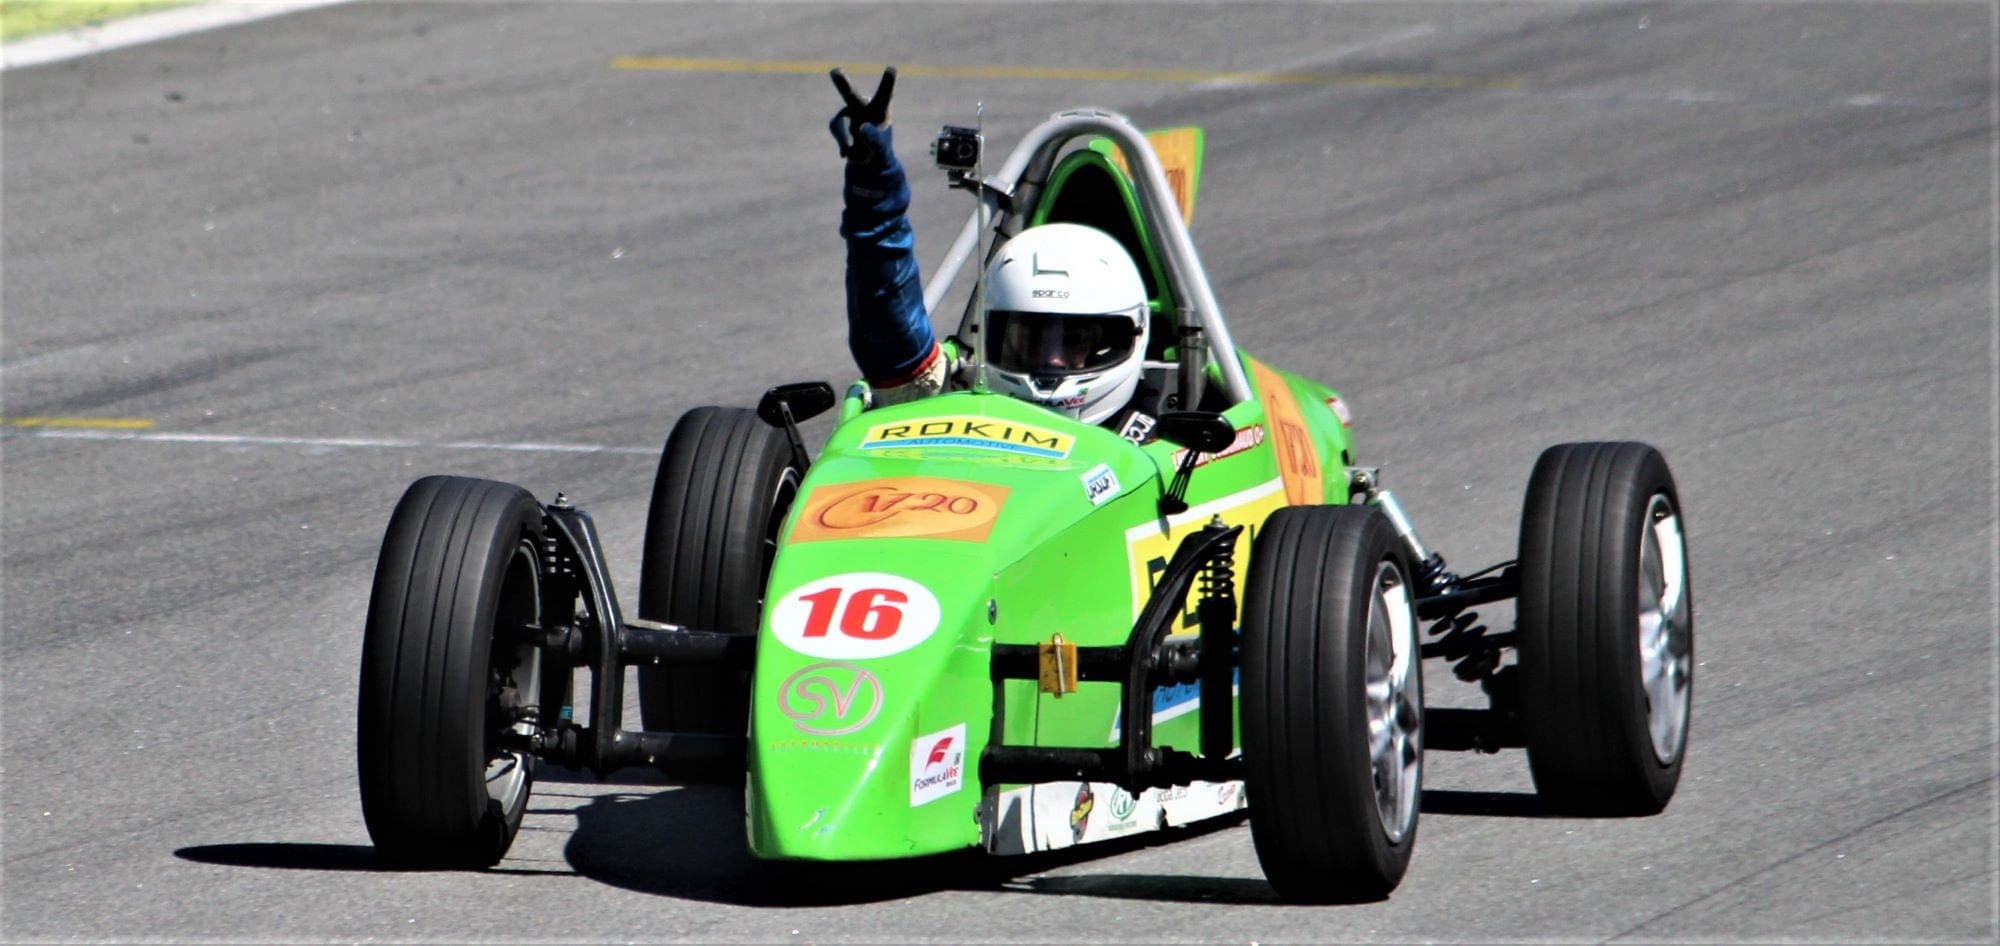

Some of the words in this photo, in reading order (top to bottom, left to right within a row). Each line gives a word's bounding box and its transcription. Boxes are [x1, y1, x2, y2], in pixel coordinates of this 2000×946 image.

[880, 420, 1060, 449] ROKIM
[908, 437, 1017, 450] AUTOMOTIVE
[798, 587, 909, 640] 16
[796, 670, 869, 719] SV
